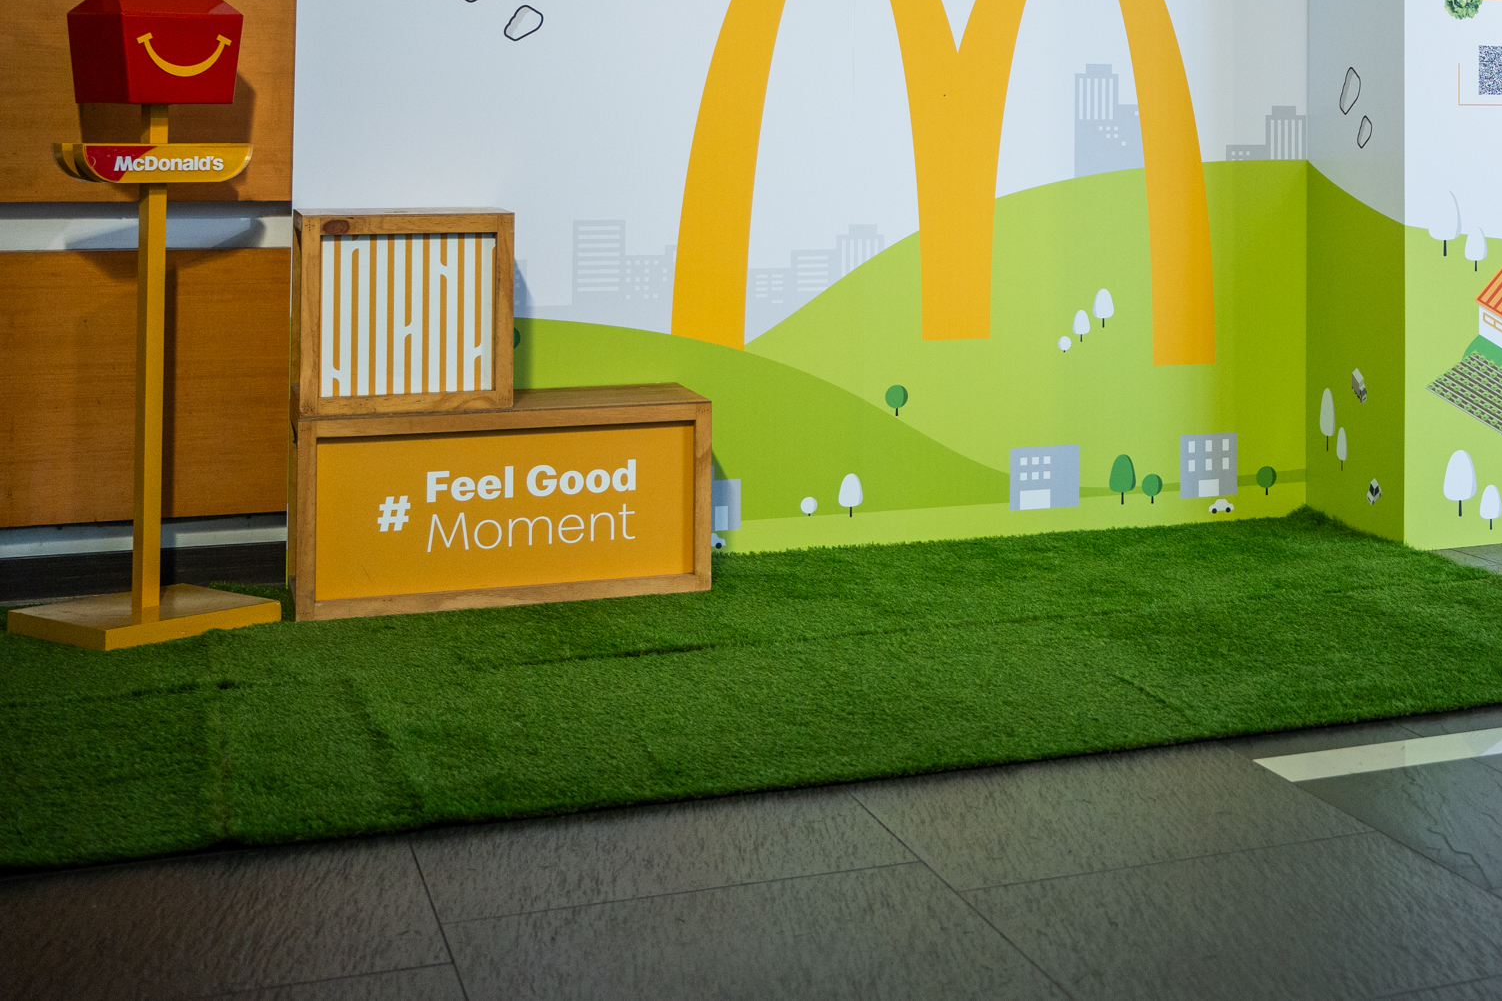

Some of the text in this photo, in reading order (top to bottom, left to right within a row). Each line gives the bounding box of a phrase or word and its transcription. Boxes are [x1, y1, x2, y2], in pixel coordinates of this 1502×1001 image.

[114, 156, 224, 172] McDonald's
[426, 459, 636, 503] Feel Good
[427, 503, 635, 552] Moment
